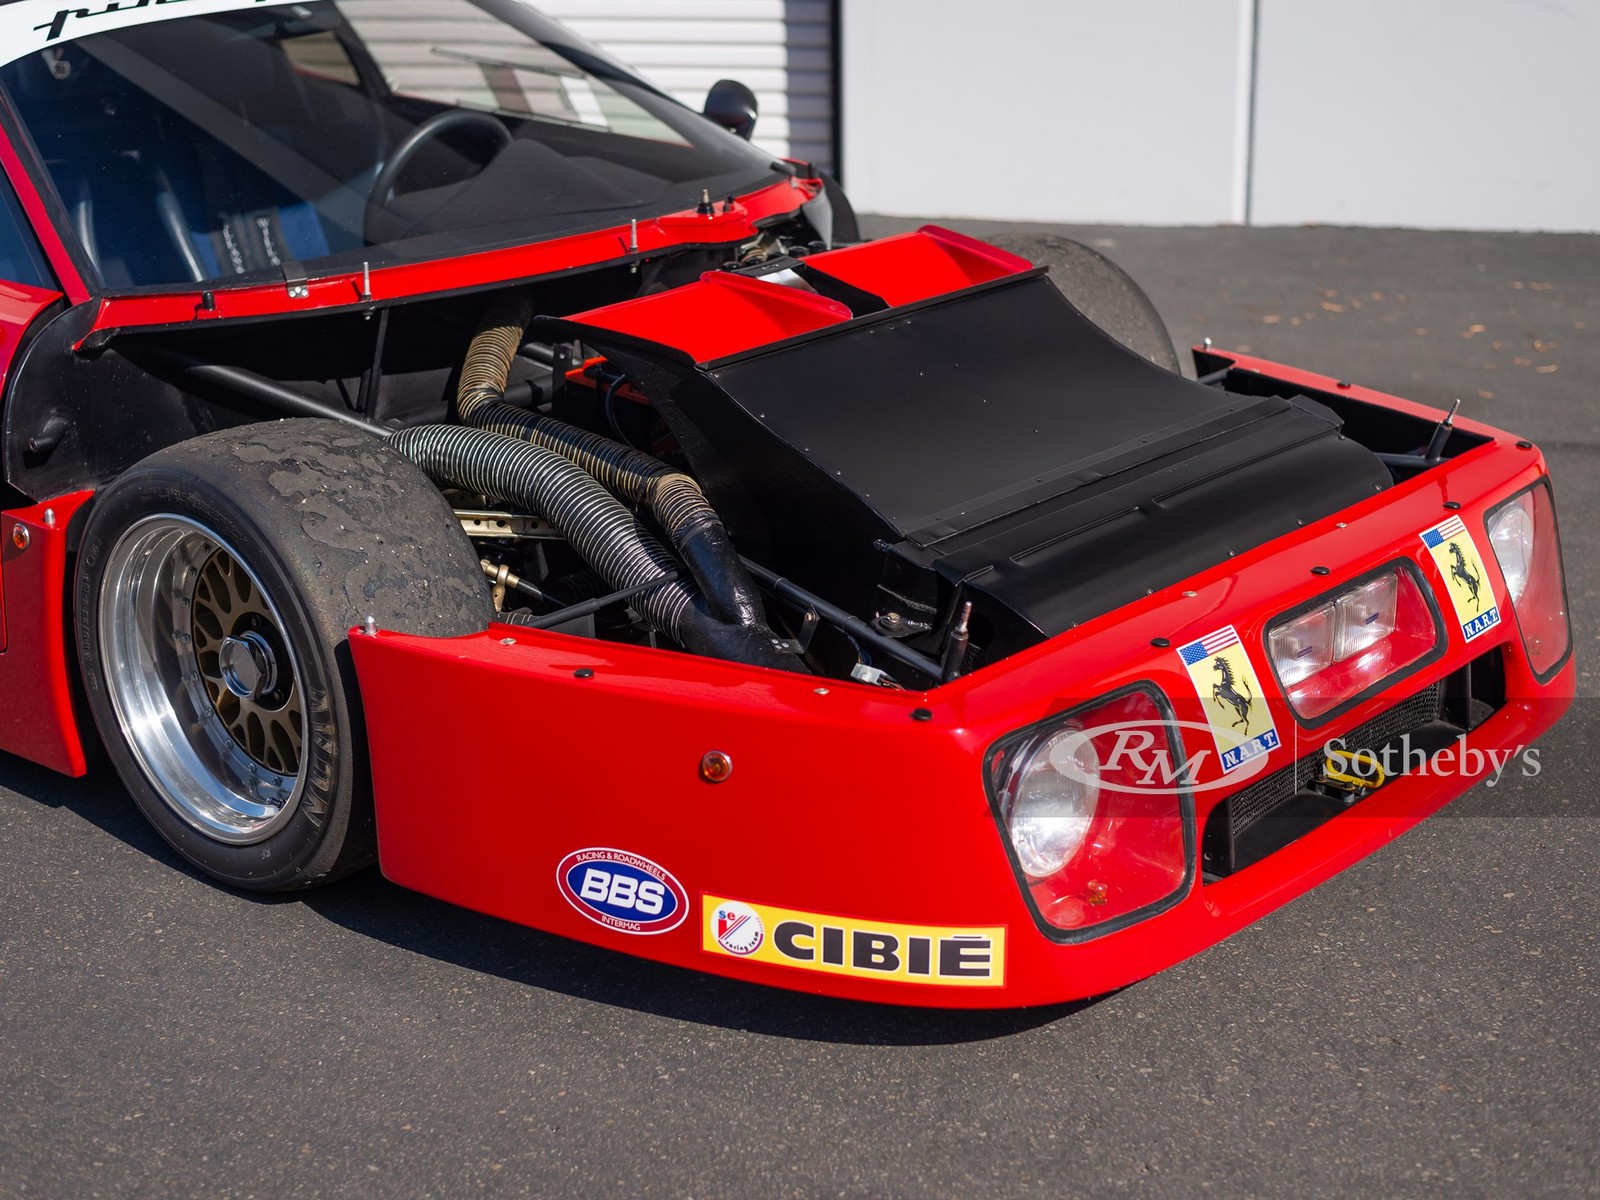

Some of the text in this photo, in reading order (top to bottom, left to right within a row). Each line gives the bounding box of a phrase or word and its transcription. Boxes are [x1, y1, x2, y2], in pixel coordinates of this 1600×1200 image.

[1223, 731, 1277, 768] N.A.R.T.
[576, 851, 667, 881] RACING & ROADWHEELS
[580, 868, 665, 915] BBS
[601, 914, 641, 931] INTERMAG
[725, 941, 749, 952] racing
[774, 921, 991, 977] CIBIÉ
